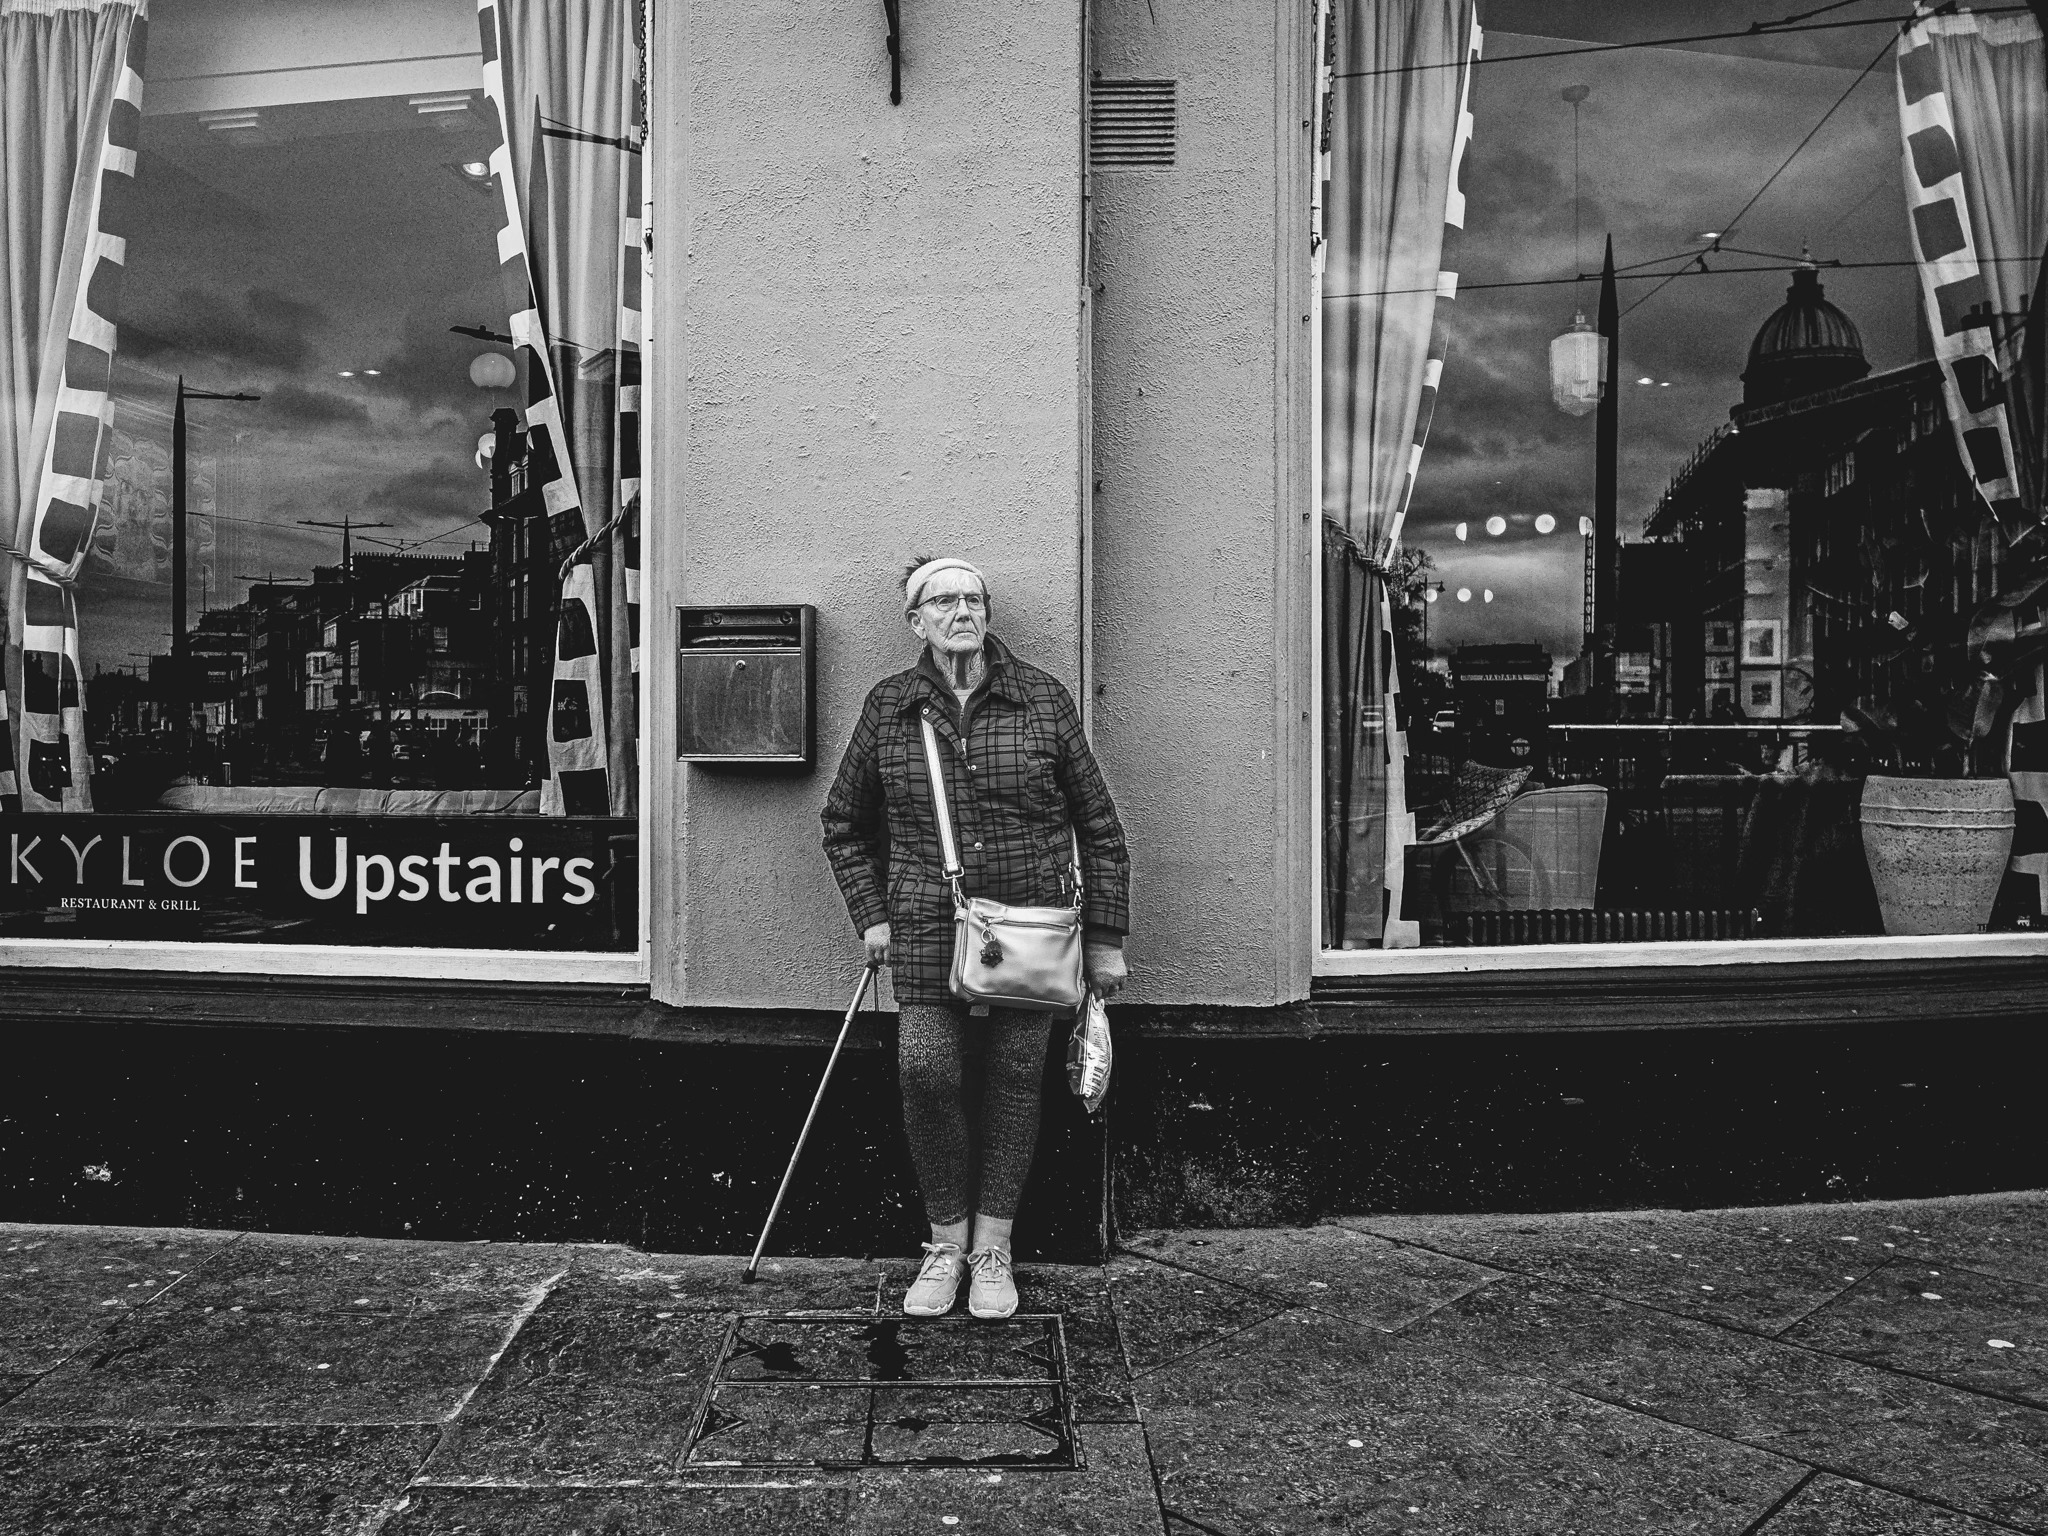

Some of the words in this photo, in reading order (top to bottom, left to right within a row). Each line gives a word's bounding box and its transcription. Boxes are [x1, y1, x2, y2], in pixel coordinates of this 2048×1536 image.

[10, 833, 258, 889] KYLOE
[299, 835, 596, 915] Upstairs
[60, 897, 145, 910] RESTAURANT
[148, 899, 157, 910] &
[160, 899, 201, 911] GRILL
